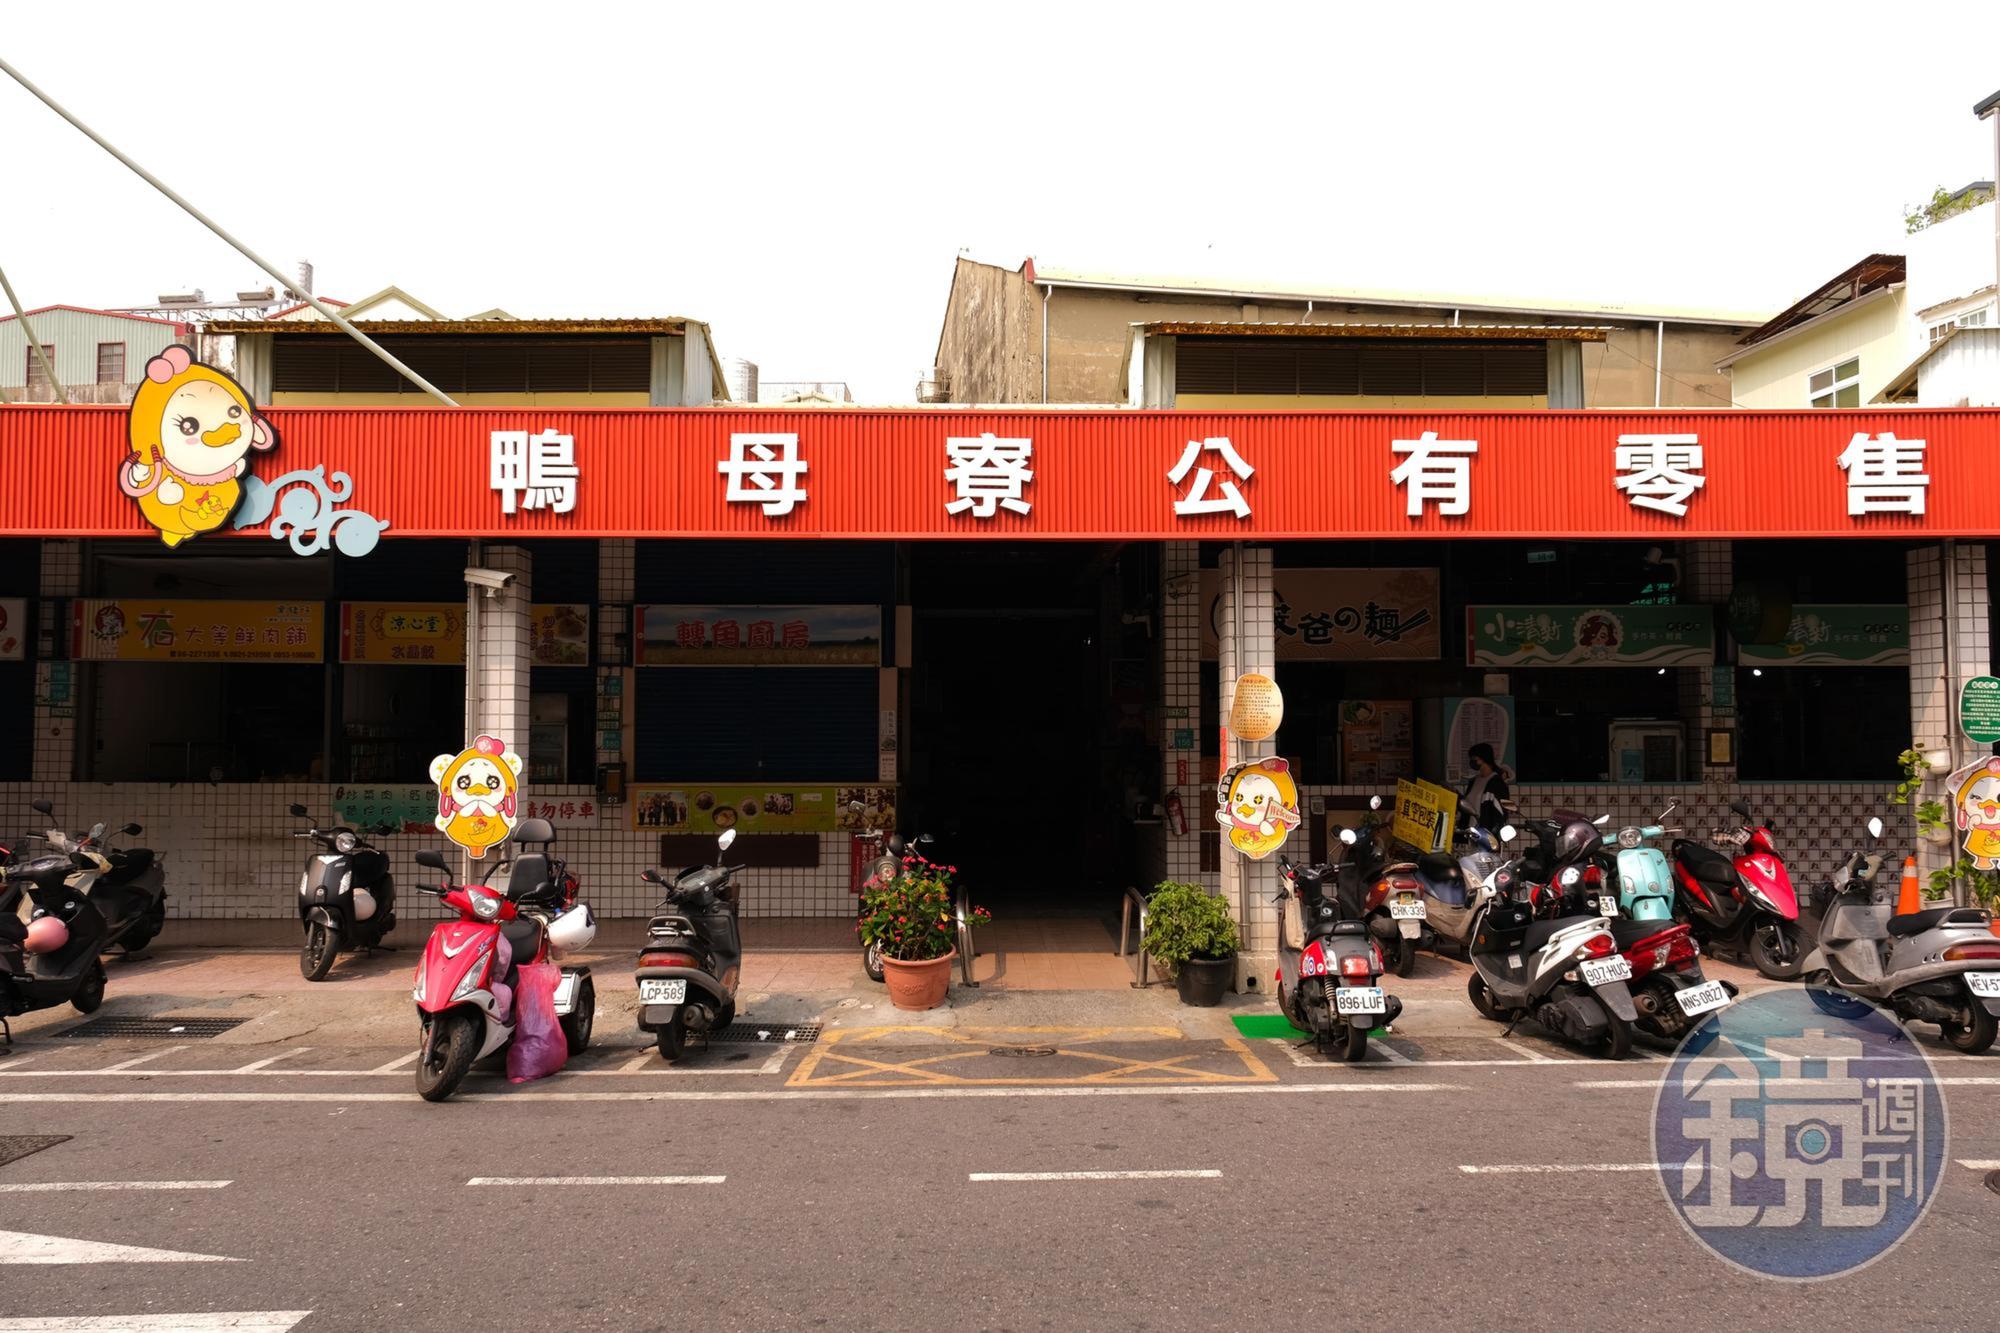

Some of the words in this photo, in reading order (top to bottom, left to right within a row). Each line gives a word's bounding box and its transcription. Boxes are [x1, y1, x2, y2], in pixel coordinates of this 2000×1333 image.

[1586, 962, 1629, 982] 907-HUC
[640, 987, 684, 1000] LCP-589
[1679, 986, 1724, 1011] MNS-0827
[1339, 996, 1383, 1010] 896-LUF
